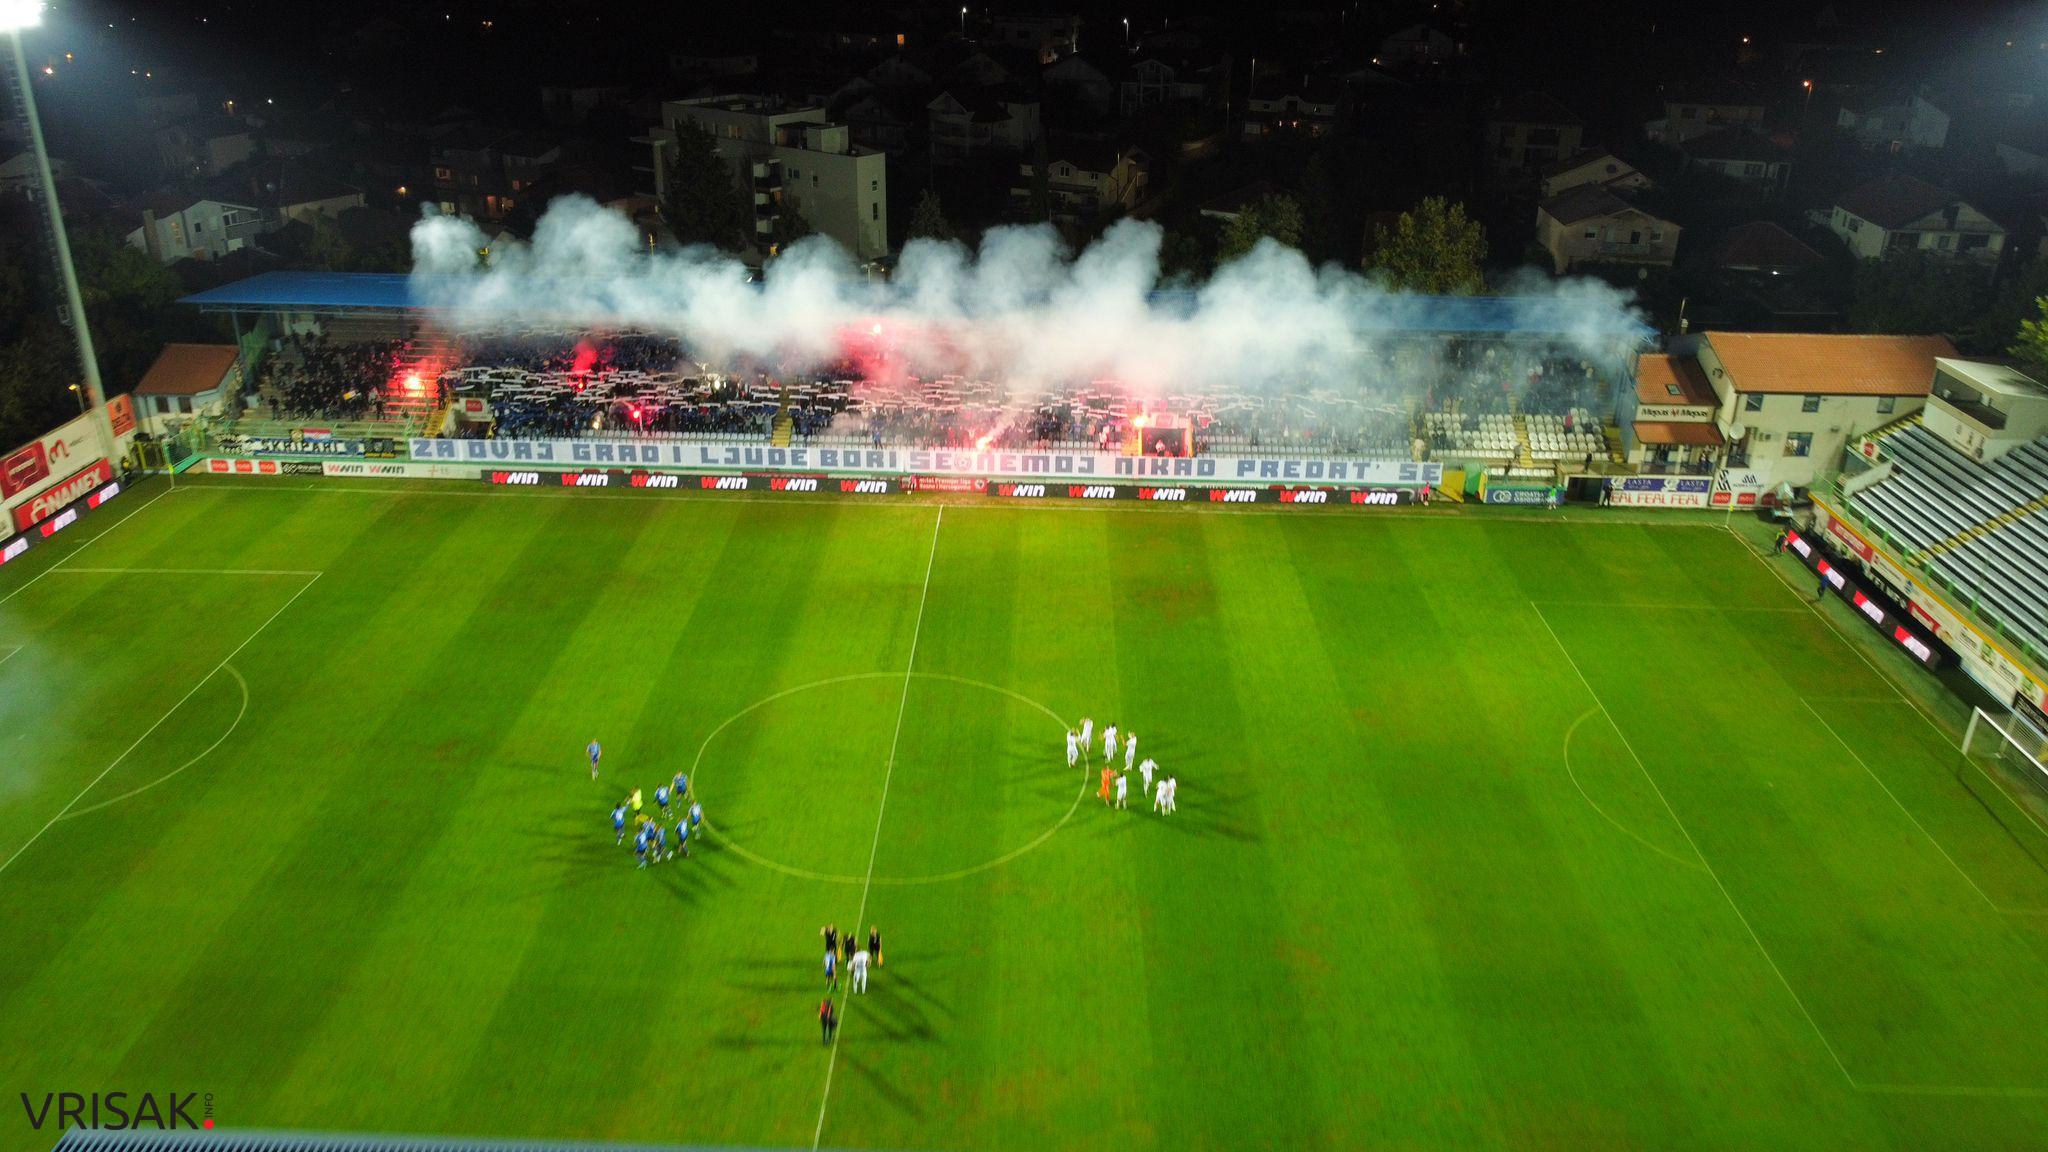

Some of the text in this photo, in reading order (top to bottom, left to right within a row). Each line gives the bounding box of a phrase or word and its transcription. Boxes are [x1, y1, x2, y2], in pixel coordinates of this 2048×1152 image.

[413, 440, 455, 457] ZA
[468, 440, 553, 460] OVAJ
[572, 443, 659, 463] GRAD
[673, 446, 681, 463] I
[701, 446, 807, 466] LJUDE
[820, 449, 897, 468] BORI
[910, 452, 951, 470] SE
[977, 454, 1094, 474] NEMOJ
[1115, 458, 1215, 476] NIKAD
[1399, 464, 1441, 481] SE
